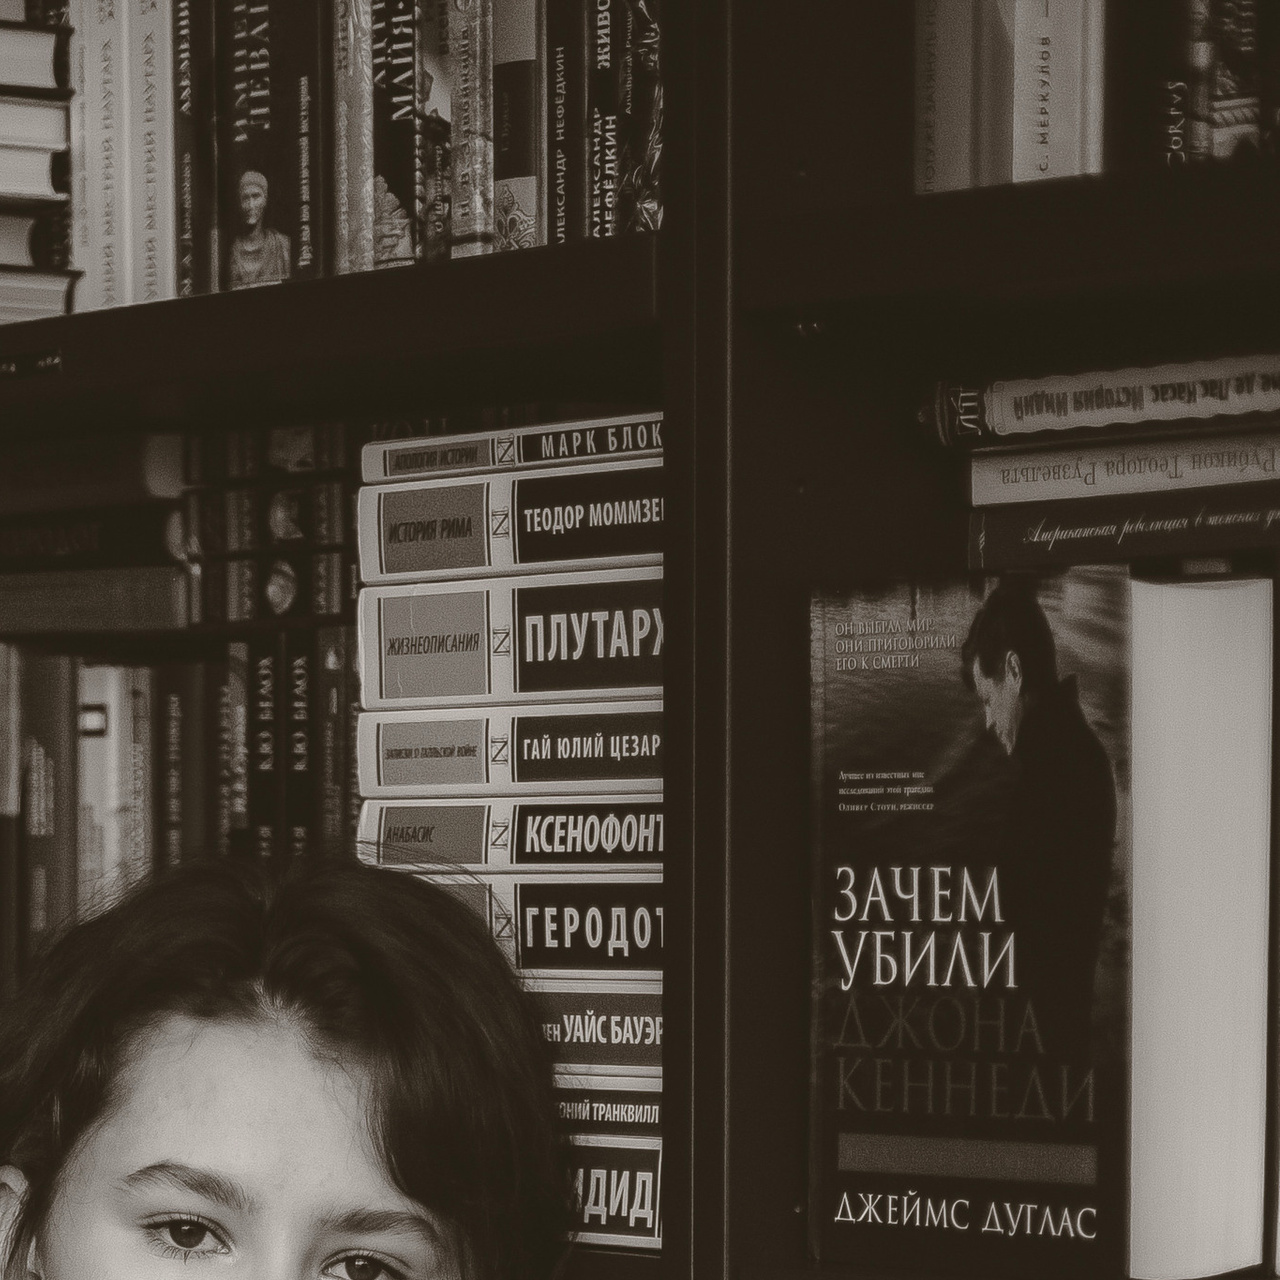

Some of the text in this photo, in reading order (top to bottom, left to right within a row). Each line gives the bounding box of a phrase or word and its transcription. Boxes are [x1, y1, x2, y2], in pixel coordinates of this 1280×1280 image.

[1038, 36, 1051, 145] МЕРКУЛОВ
[555, 148, 568, 244] ЛЕКСАНДР
[541, 422, 663, 459] МАРК БЛОК
[1000, 460, 1097, 487] Рузвельта
[1104, 453, 1184, 481] Теодора
[388, 516, 473, 544] ИСТОРИЯ РИМА
[524, 504, 585, 534] ТЕОДОР
[387, 632, 481, 657] ЖИЗНЕОПИСАНИЯ
[835, 622, 854, 637] ОН
[835, 635, 957, 654] ОНИ ПРИГОВОРИЛИ
[835, 657, 858, 672] ЕГО
[872, 654, 920, 670] СМЕРТИ
[523, 730, 661, 760] ГАЙ ЮЛИЙ ЦЕЗАР
[386, 825, 436, 843] АНАБАСИС
[834, 866, 1005, 922] ЗАЧЕМ
[831, 929, 1019, 992] УБИЛИ
[563, 1009, 607, 1043] УАЙС
[834, 999, 1045, 1055] ДЖОНА
[835, 1057, 1096, 1124] КЕННЕДИ
[834, 1189, 1097, 1240] ДЖЕЙМС ДУГЛАС
